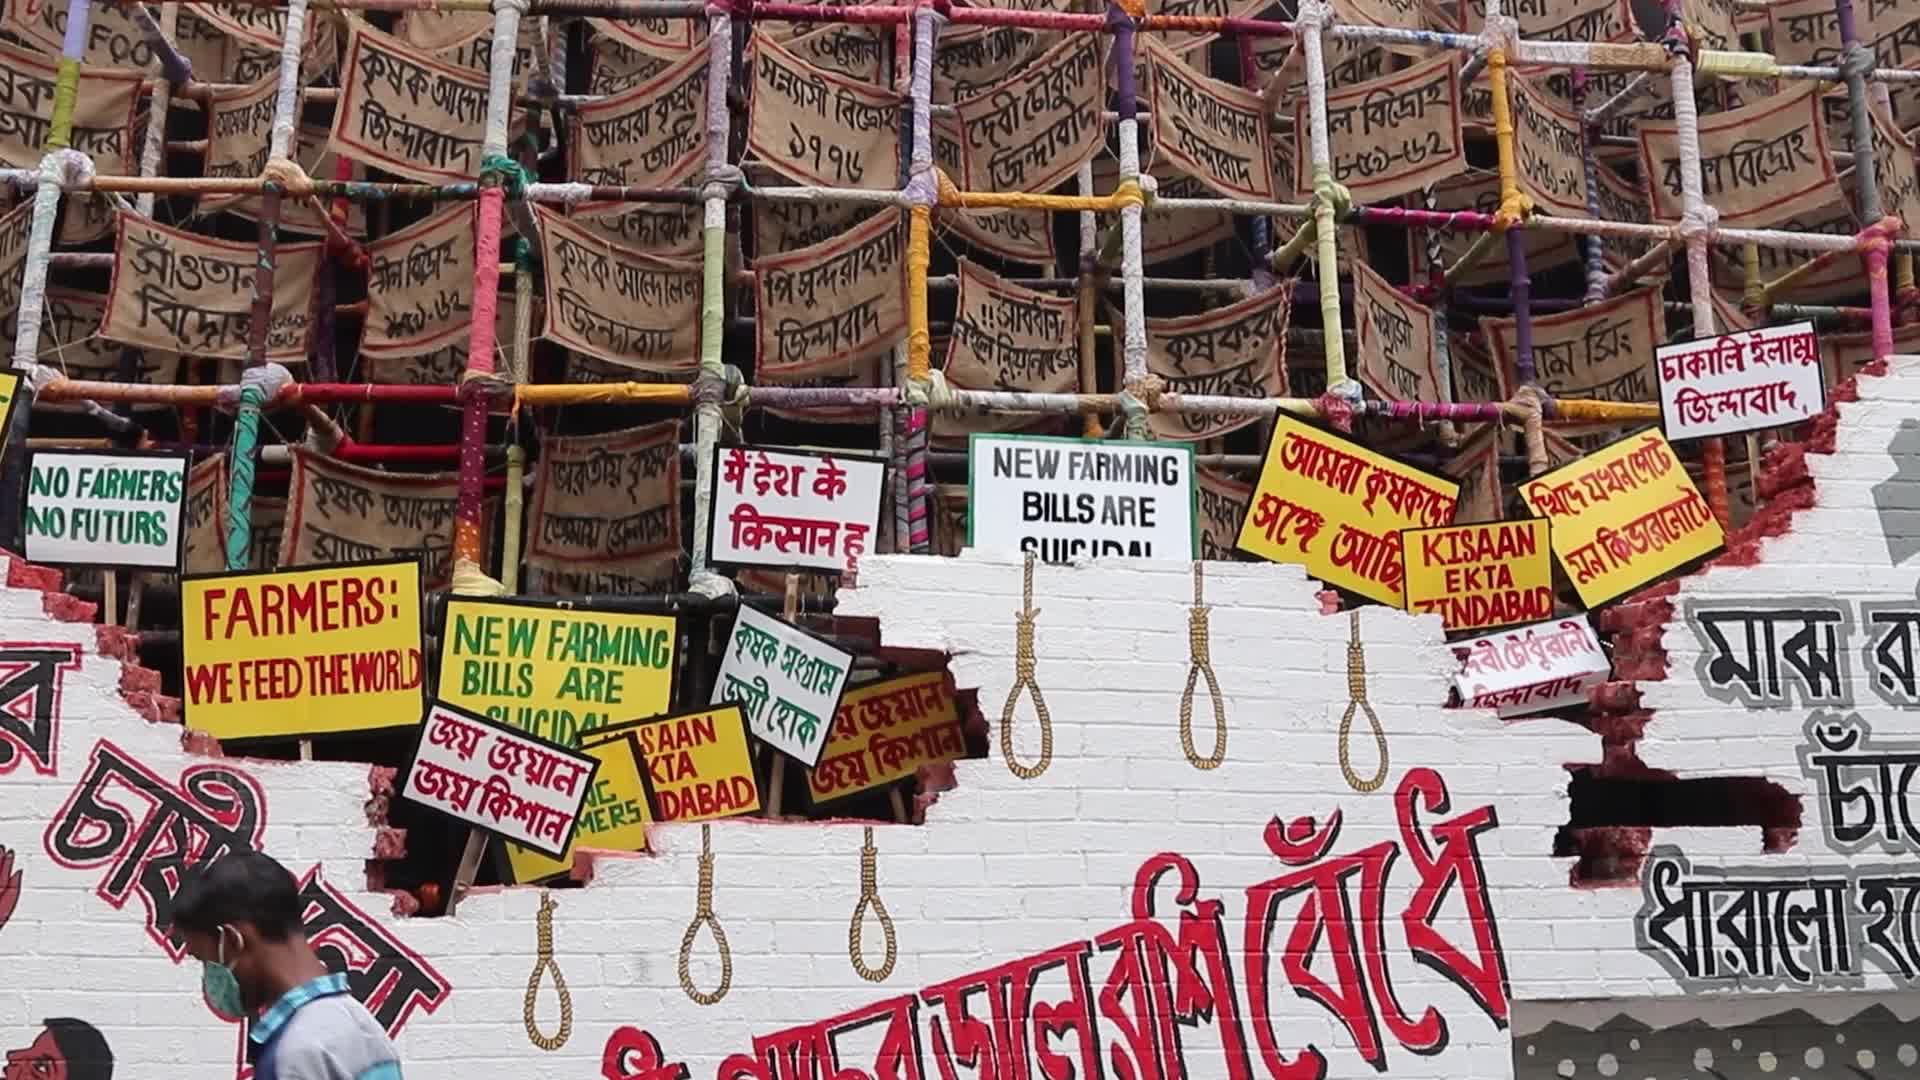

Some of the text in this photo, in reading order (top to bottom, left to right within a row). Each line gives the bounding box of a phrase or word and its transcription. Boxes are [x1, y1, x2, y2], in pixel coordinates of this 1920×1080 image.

[1660, 335, 1747, 383] চাকালি
[30, 466, 184, 503] NO FARMERS
[812, 452, 848, 502] के
[992, 446, 1180, 487] NEW FARMING
[1280, 431, 1371, 496] আমরা
[26, 506, 169, 547] NO FUTURS
[728, 503, 840, 558] किसान
[1021, 490, 1156, 528] BILLS ARE
[1420, 523, 1537, 568] KISAAN
[1563, 542, 1609, 586] মন
[1444, 563, 1515, 594] EKTA
[203, 576, 399, 641] FARMERS:
[452, 613, 670, 670] NEW FARMING
[734, 621, 780, 669] কৃষক
[1695, 610, 1841, 698] মাঝ
[186, 661, 233, 706] WE
[239, 657, 303, 702] FEED
[460, 659, 625, 704] BILLS ARE
[429, 712, 487, 761] জয়
[640, 715, 718, 755] SAAN
[766, 695, 822, 751] হোক
[412, 758, 481, 813] জয়
[476, 774, 573, 845] কিশান
[655, 775, 756, 822] DABAD
[1649, 859, 1851, 983] ধারালো
